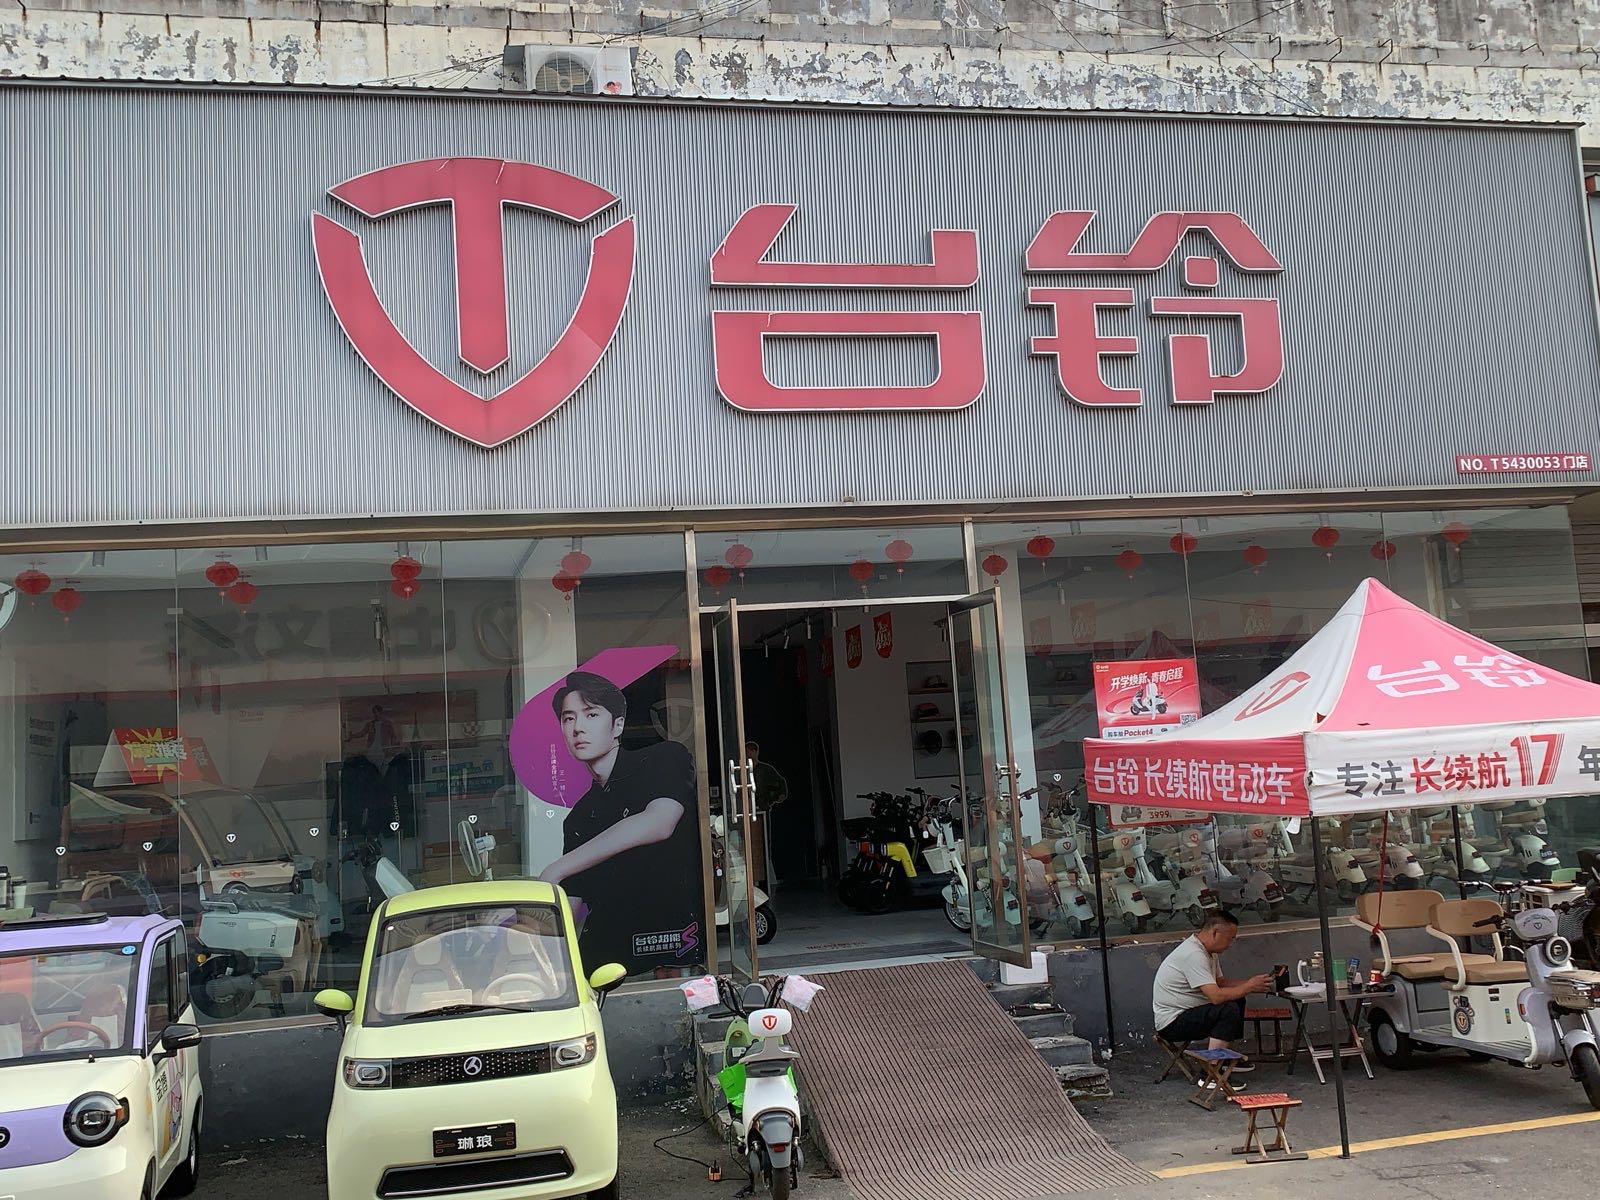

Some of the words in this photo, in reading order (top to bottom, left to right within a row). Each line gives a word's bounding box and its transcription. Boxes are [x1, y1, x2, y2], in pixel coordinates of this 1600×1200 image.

[710, 203, 1283, 412] 台铃
[1367, 654, 1547, 698] 台铃
[457, 1134, 493, 1150] 琳琅
